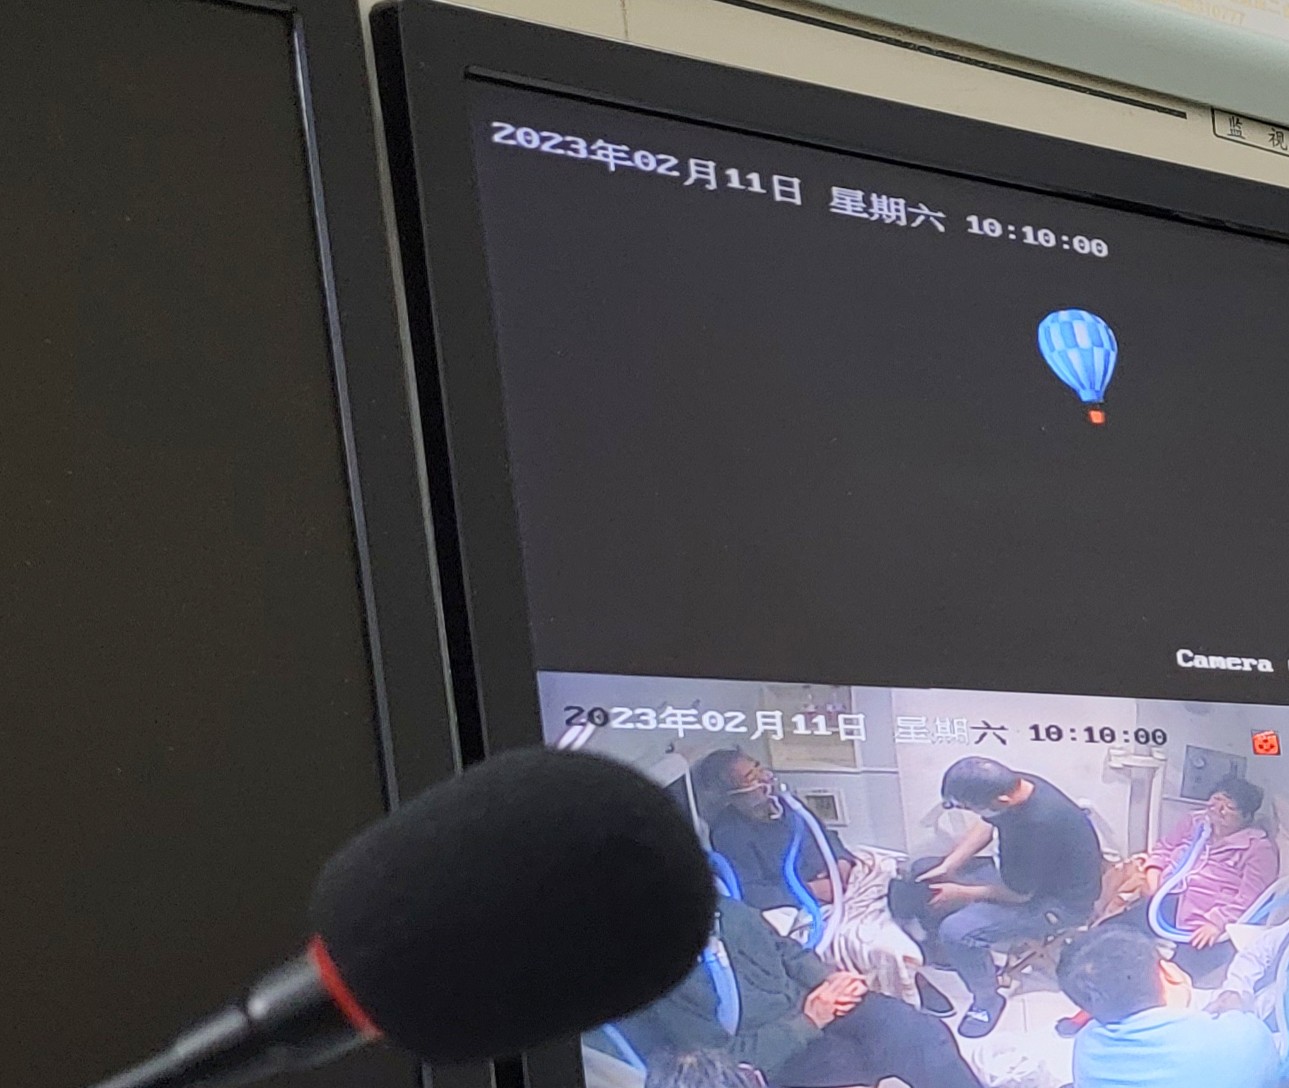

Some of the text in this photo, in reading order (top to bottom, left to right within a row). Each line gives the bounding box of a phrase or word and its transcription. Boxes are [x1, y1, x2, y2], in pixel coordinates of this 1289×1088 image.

[491, 121, 1109, 257] 2023年02月11日 星期六 10:10:00
[1176, 649, 1274, 675] Camera
[564, 706, 1168, 745] 2023年02月11日 星期六 10:10:00
